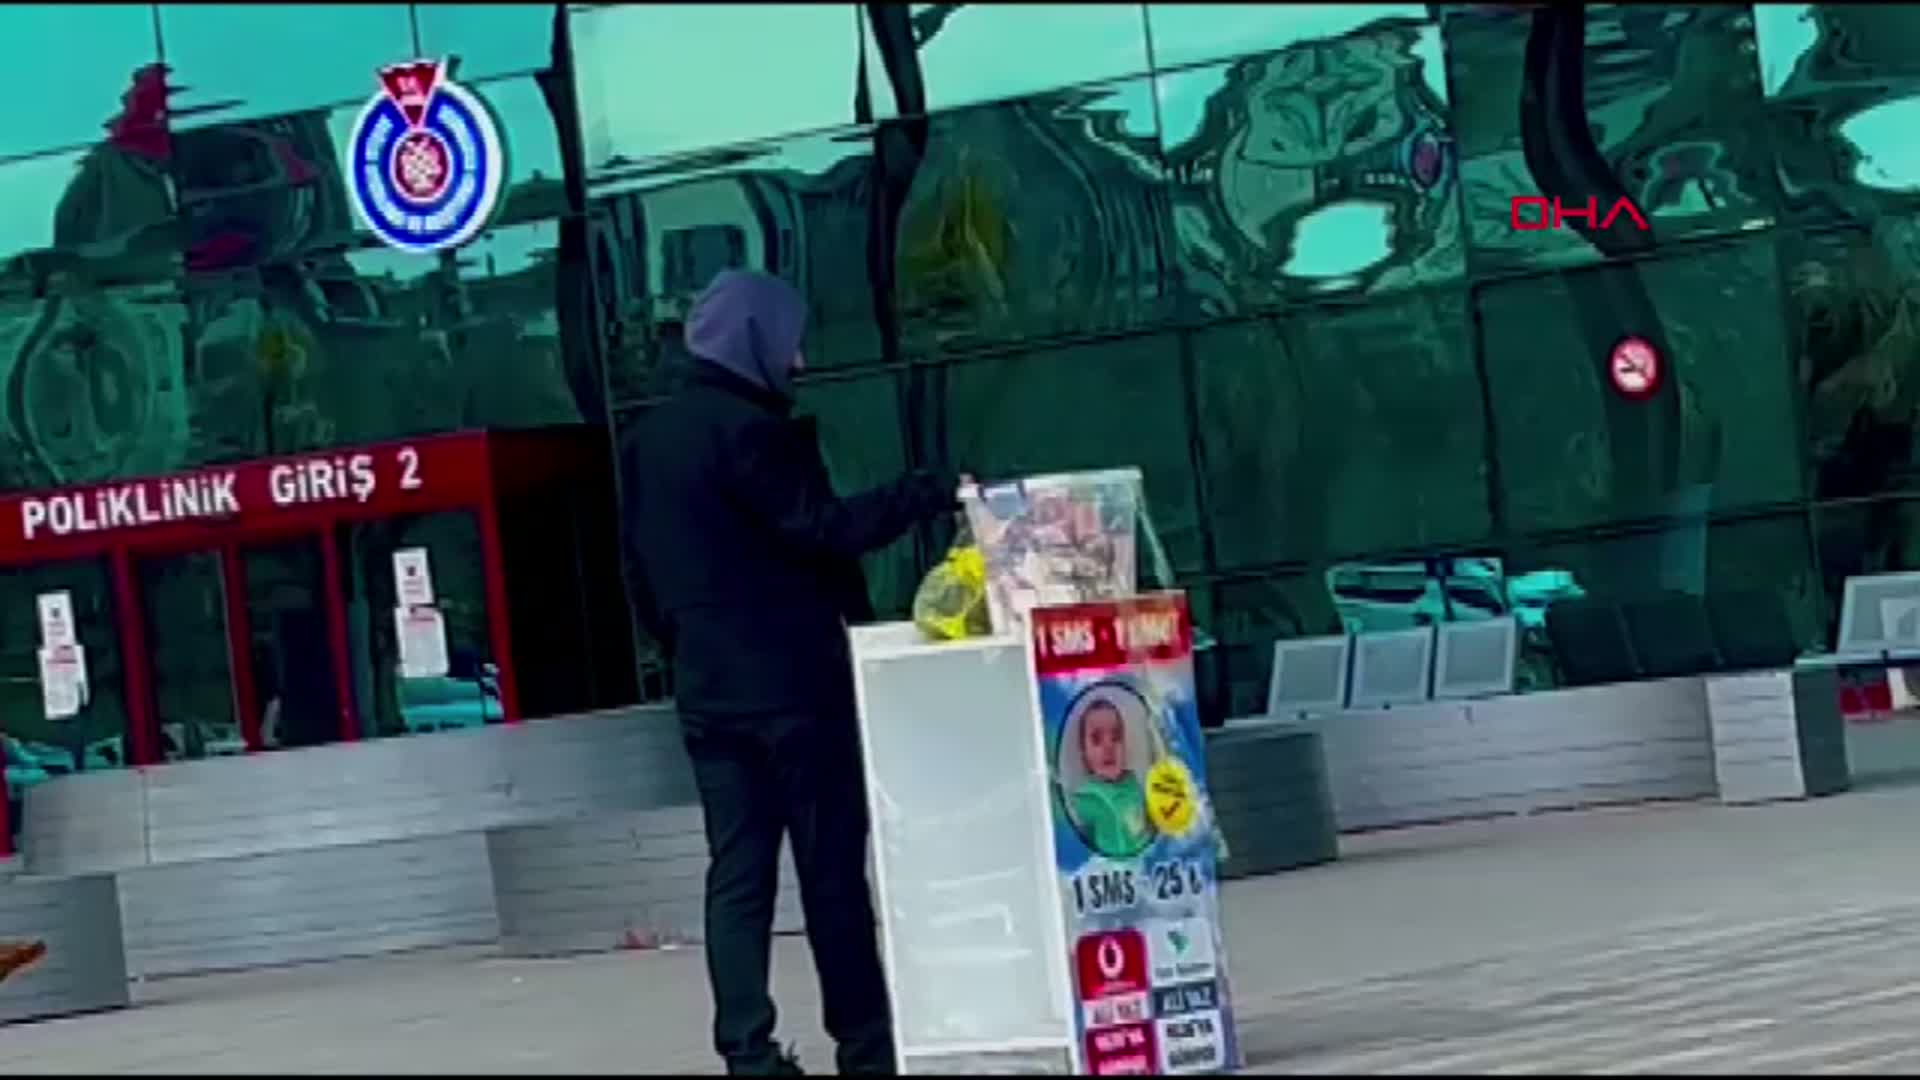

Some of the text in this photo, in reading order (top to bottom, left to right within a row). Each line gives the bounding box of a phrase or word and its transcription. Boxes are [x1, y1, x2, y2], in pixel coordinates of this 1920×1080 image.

[398, 446, 422, 489] 2
[1052, 620, 1095, 655] SMS
[1087, 869, 1136, 908] SMS
[1154, 861, 1183, 900] 25
